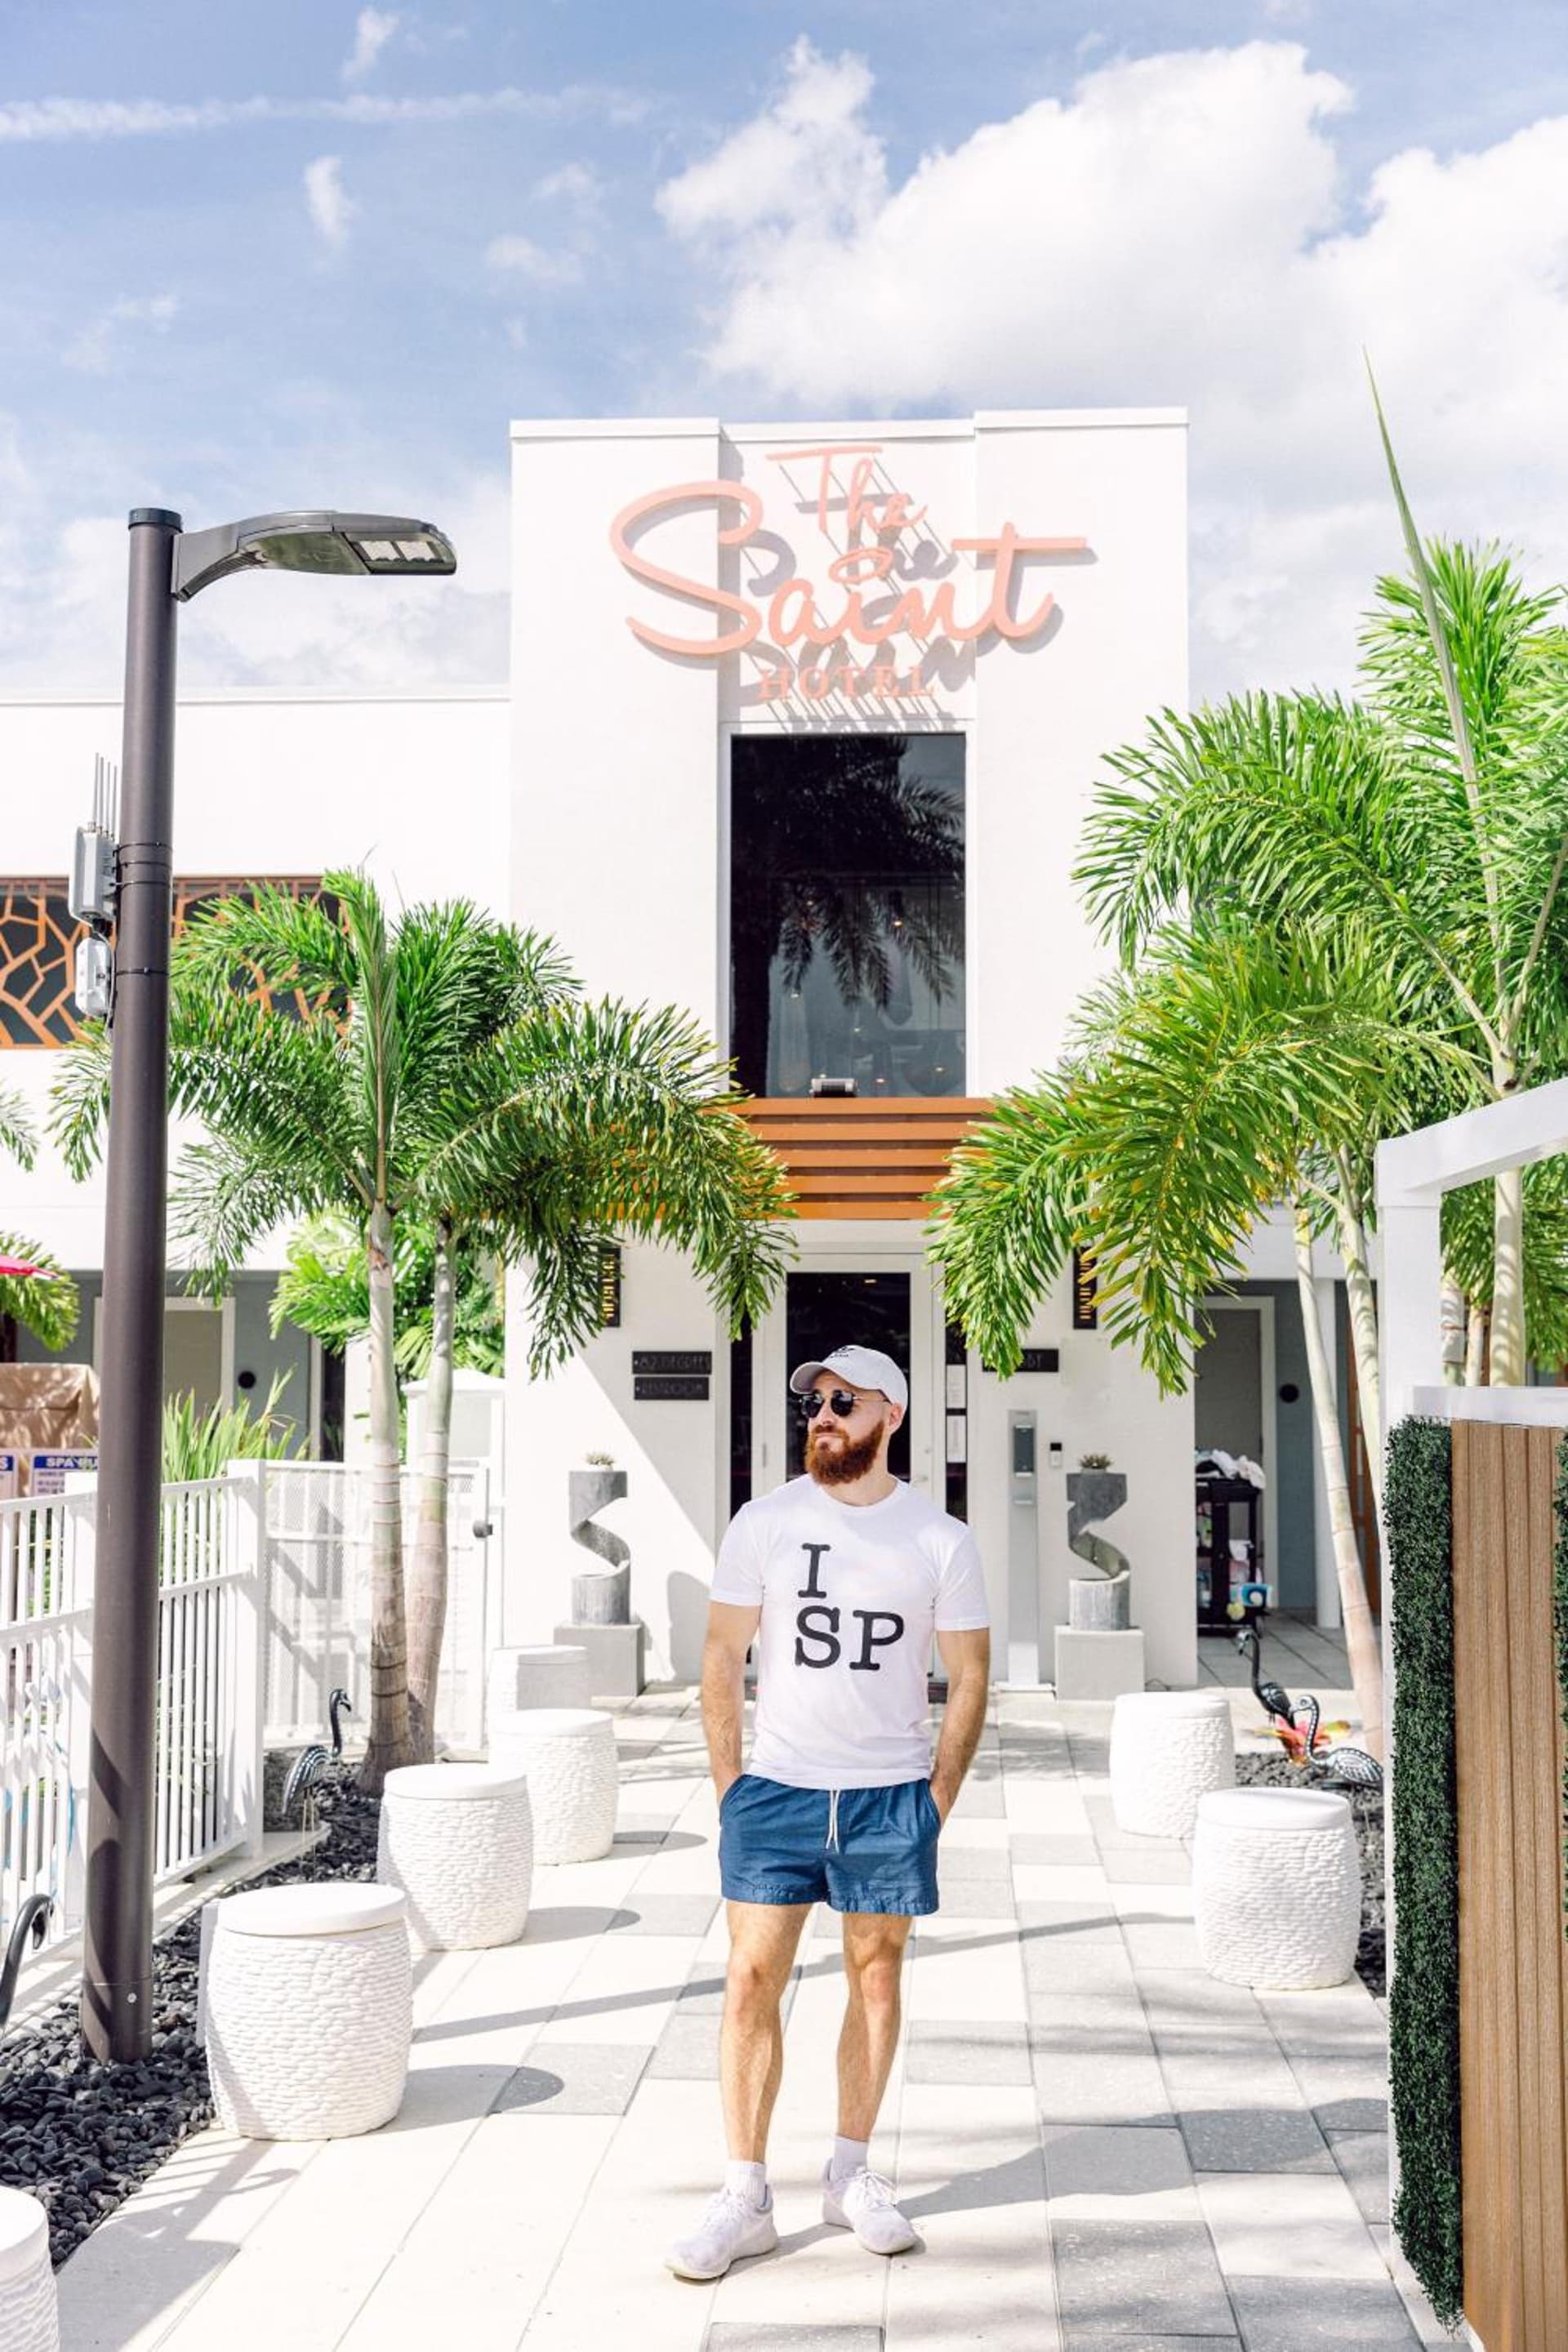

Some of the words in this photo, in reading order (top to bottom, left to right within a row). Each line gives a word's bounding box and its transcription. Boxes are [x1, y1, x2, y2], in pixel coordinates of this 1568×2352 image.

[765, 445, 929, 534] The
[609, 479, 1087, 654] Saint
[757, 665, 937, 701] HOTEL
[46, 1457, 75, 1469] SPA
[797, 1543, 831, 1598] I
[795, 1605, 905, 1671] SP
